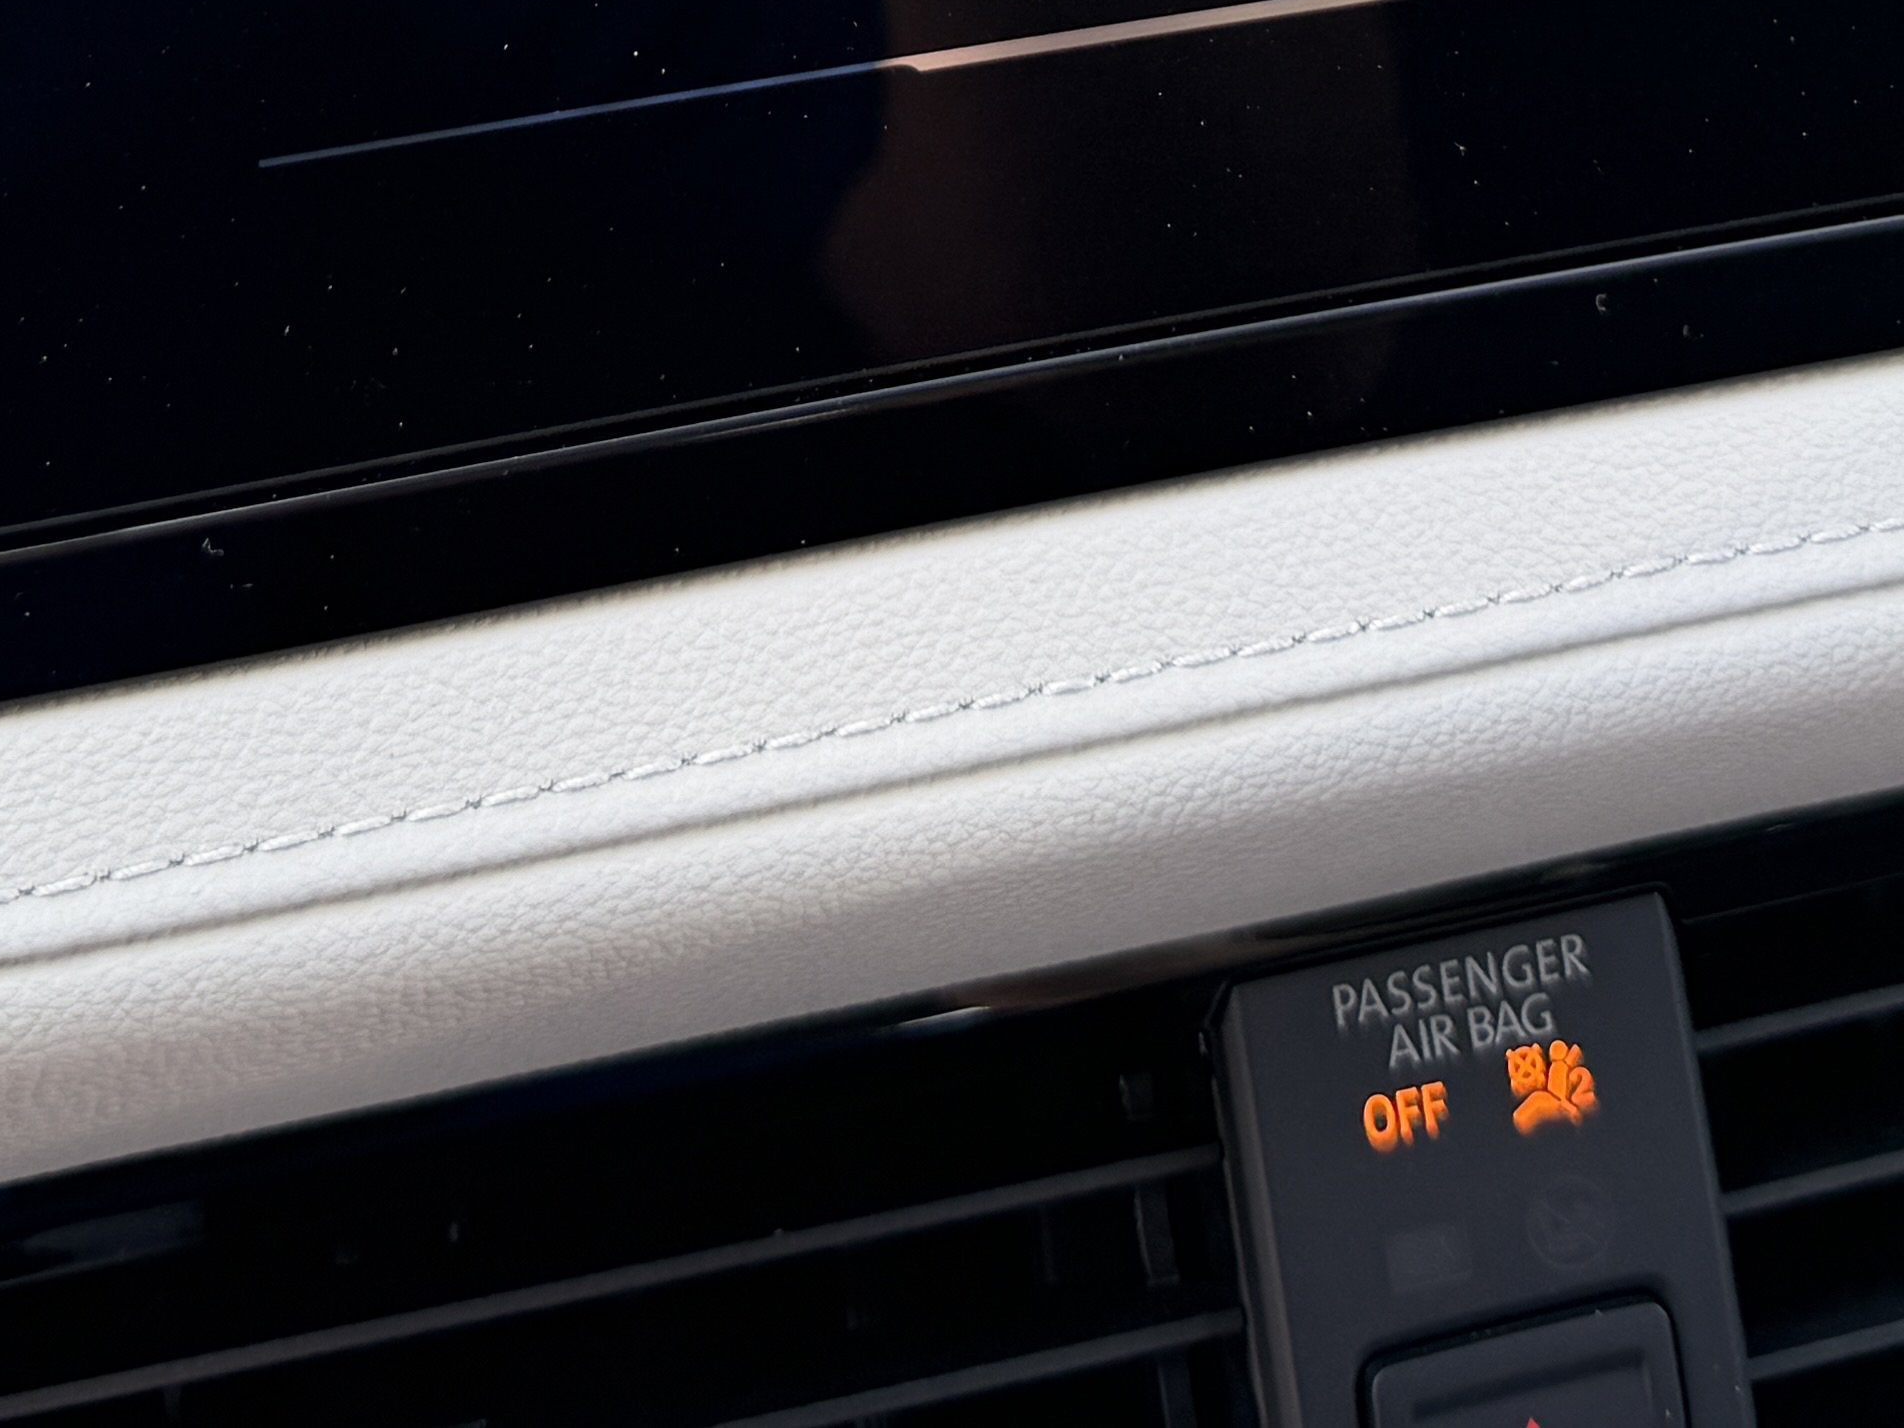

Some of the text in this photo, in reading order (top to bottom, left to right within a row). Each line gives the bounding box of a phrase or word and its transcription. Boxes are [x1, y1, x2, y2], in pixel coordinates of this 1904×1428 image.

[1332, 932, 1592, 1032] PASSENGER
[1388, 990, 1558, 1070] AIR BAG
[1362, 1080, 1451, 1152] OFF
